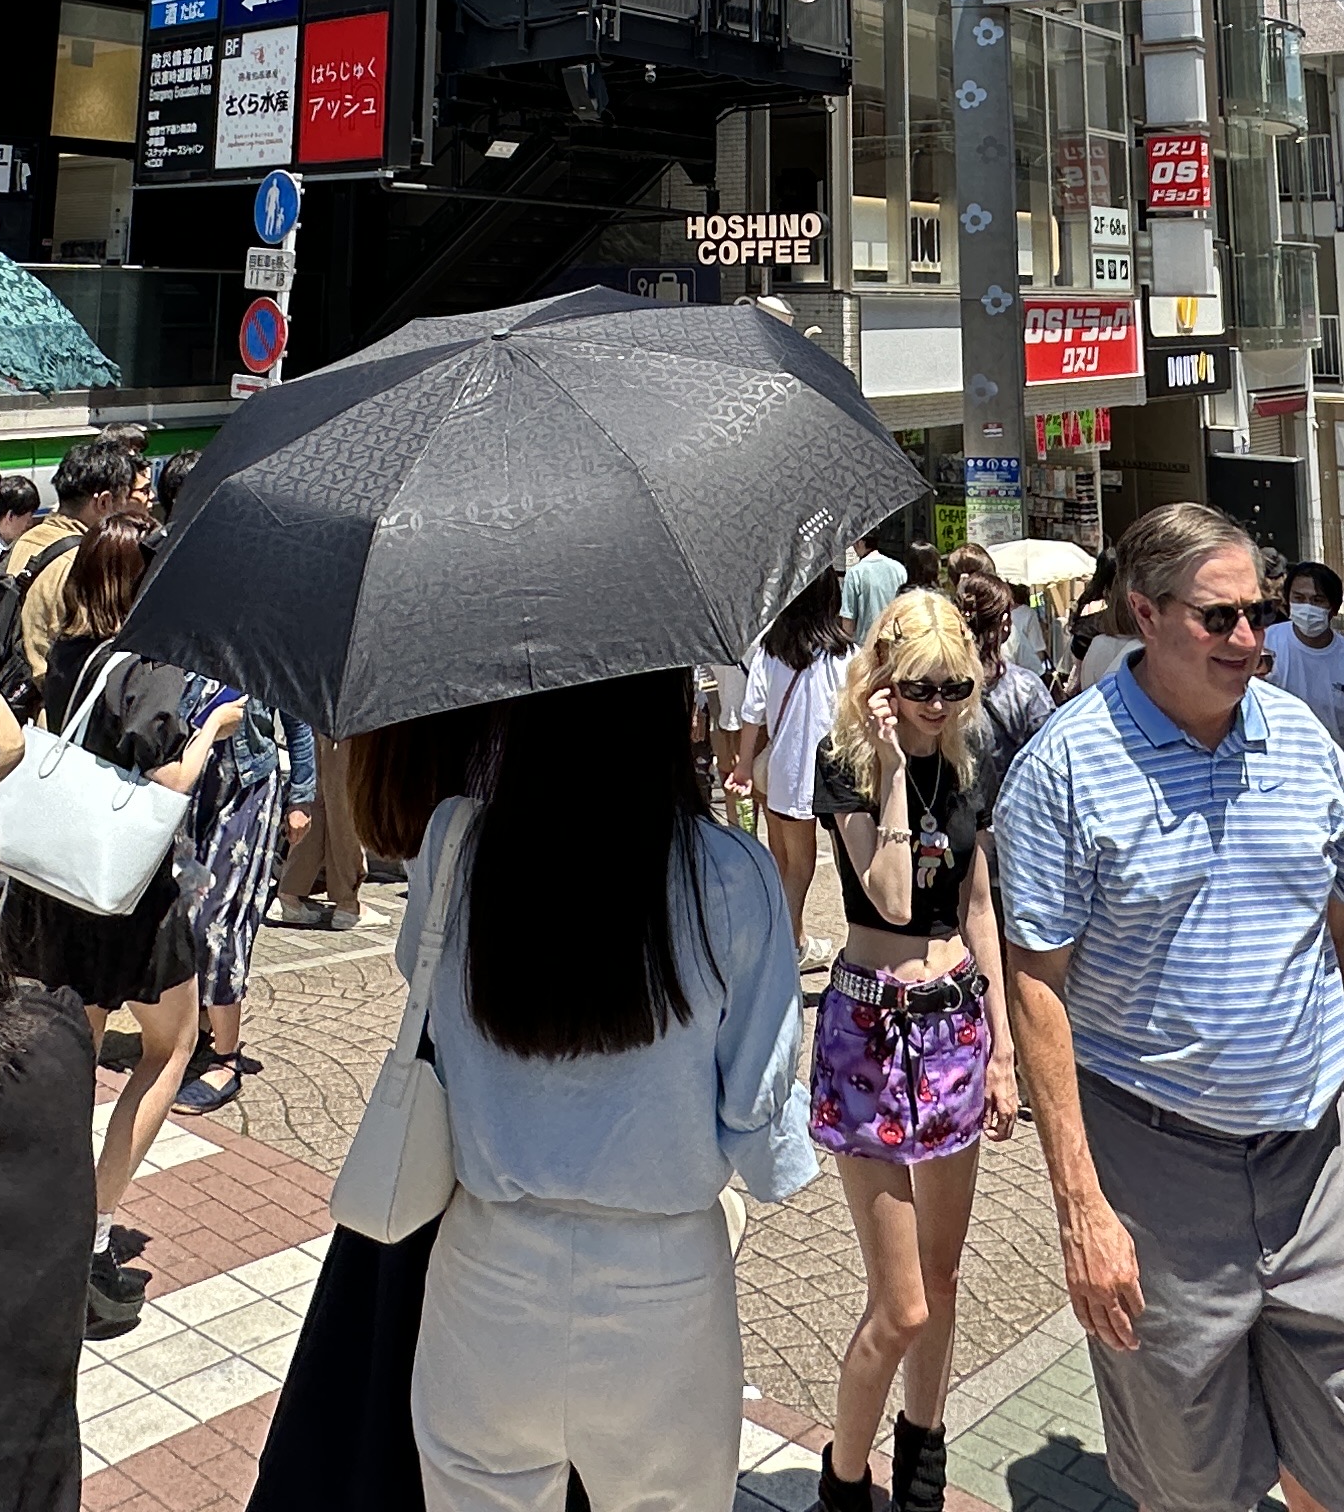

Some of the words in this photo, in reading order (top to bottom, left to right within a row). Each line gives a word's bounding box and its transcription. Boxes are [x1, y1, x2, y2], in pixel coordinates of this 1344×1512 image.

[164, 2, 177, 25] 酒
[180, 0, 205, 19] たばこ
[225, 38, 240, 56] BF
[311, 56, 377, 84] はらじゅく
[225, 90, 289, 117] さくら水産
[308, 95, 377, 122] アッシュ
[1152, 141, 1196, 157] クスリ
[1152, 161, 1199, 184] OS
[1152, 188, 1201, 202] ドラッグ
[686, 214, 822, 240] HOSHINO
[697, 240, 812, 265] COFFEE
[1024, 308, 1129, 344] OSドラッグ
[1062, 346, 1099, 373] クスリ
